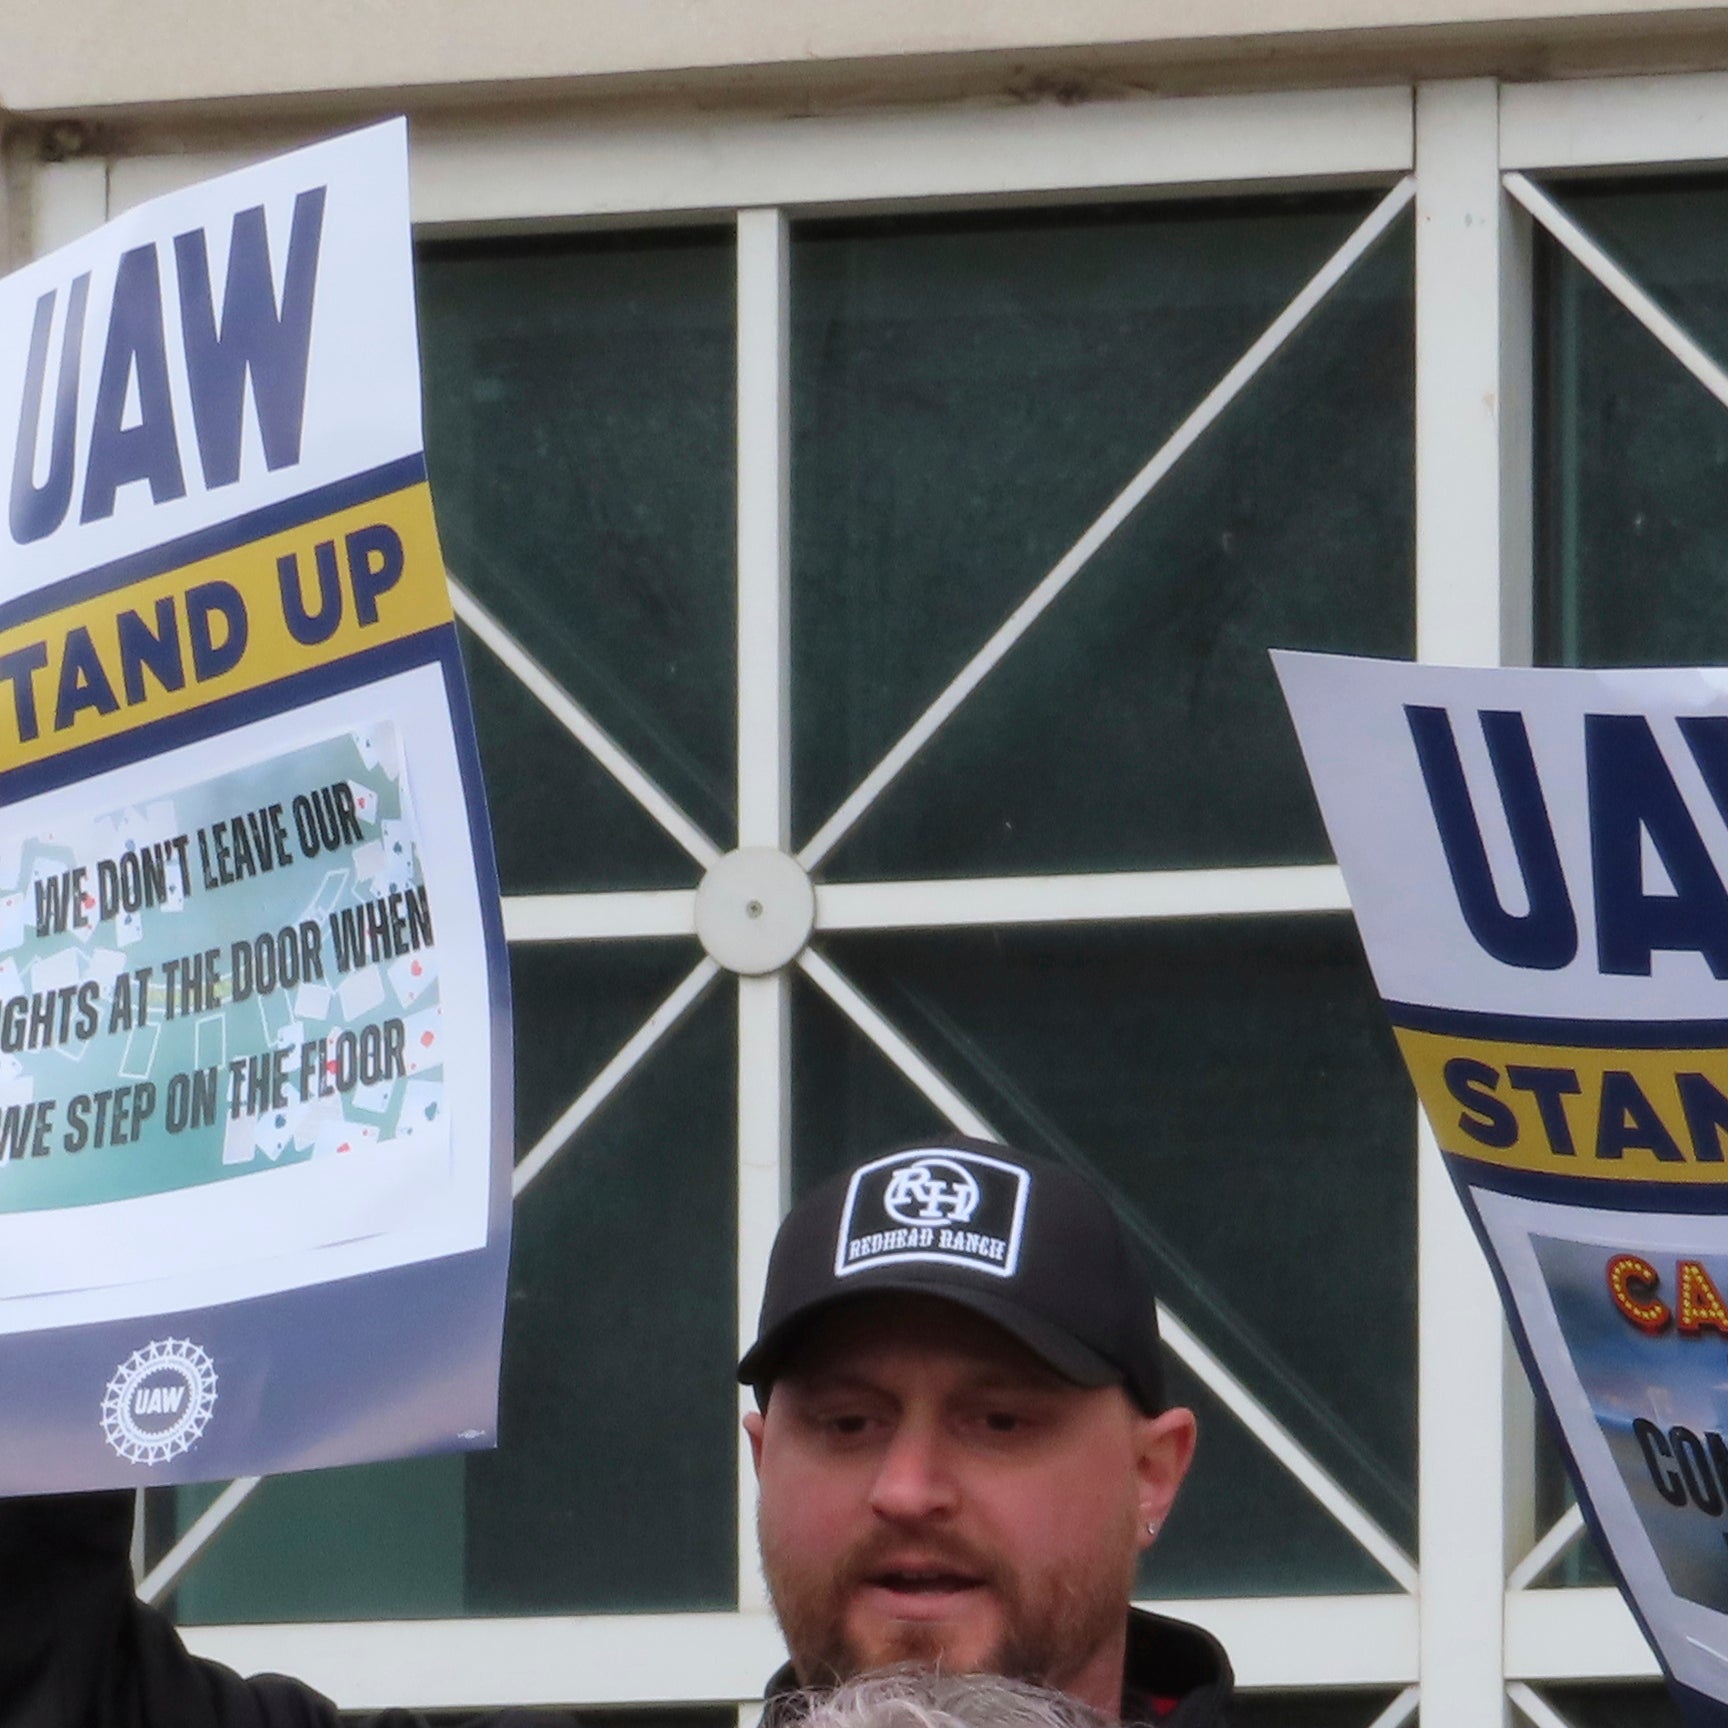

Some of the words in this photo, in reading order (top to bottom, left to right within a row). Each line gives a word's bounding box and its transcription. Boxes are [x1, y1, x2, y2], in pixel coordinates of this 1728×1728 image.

[8, 184, 328, 546] UAW
[275, 523, 405, 646] UP
[33, 872, 91, 939] WE
[98, 834, 190, 921] DON'T
[197, 805, 293, 889] LEAVE
[296, 780, 364, 856] OUR
[108, 969, 158, 1034] AT
[161, 948, 224, 1020] THE
[229, 920, 323, 1000] DOOR
[329, 885, 435, 973] WHEN
[64, 1082, 156, 1153] STEP
[165, 1067, 217, 1130] ON
[227, 1053, 294, 1120] THE
[299, 1018, 407, 1099] FLOOR
[848, 1227, 934, 1260] REDHEAD
[939, 1230, 1007, 1261] RANCH
[135, 1386, 186, 1415] UAW
